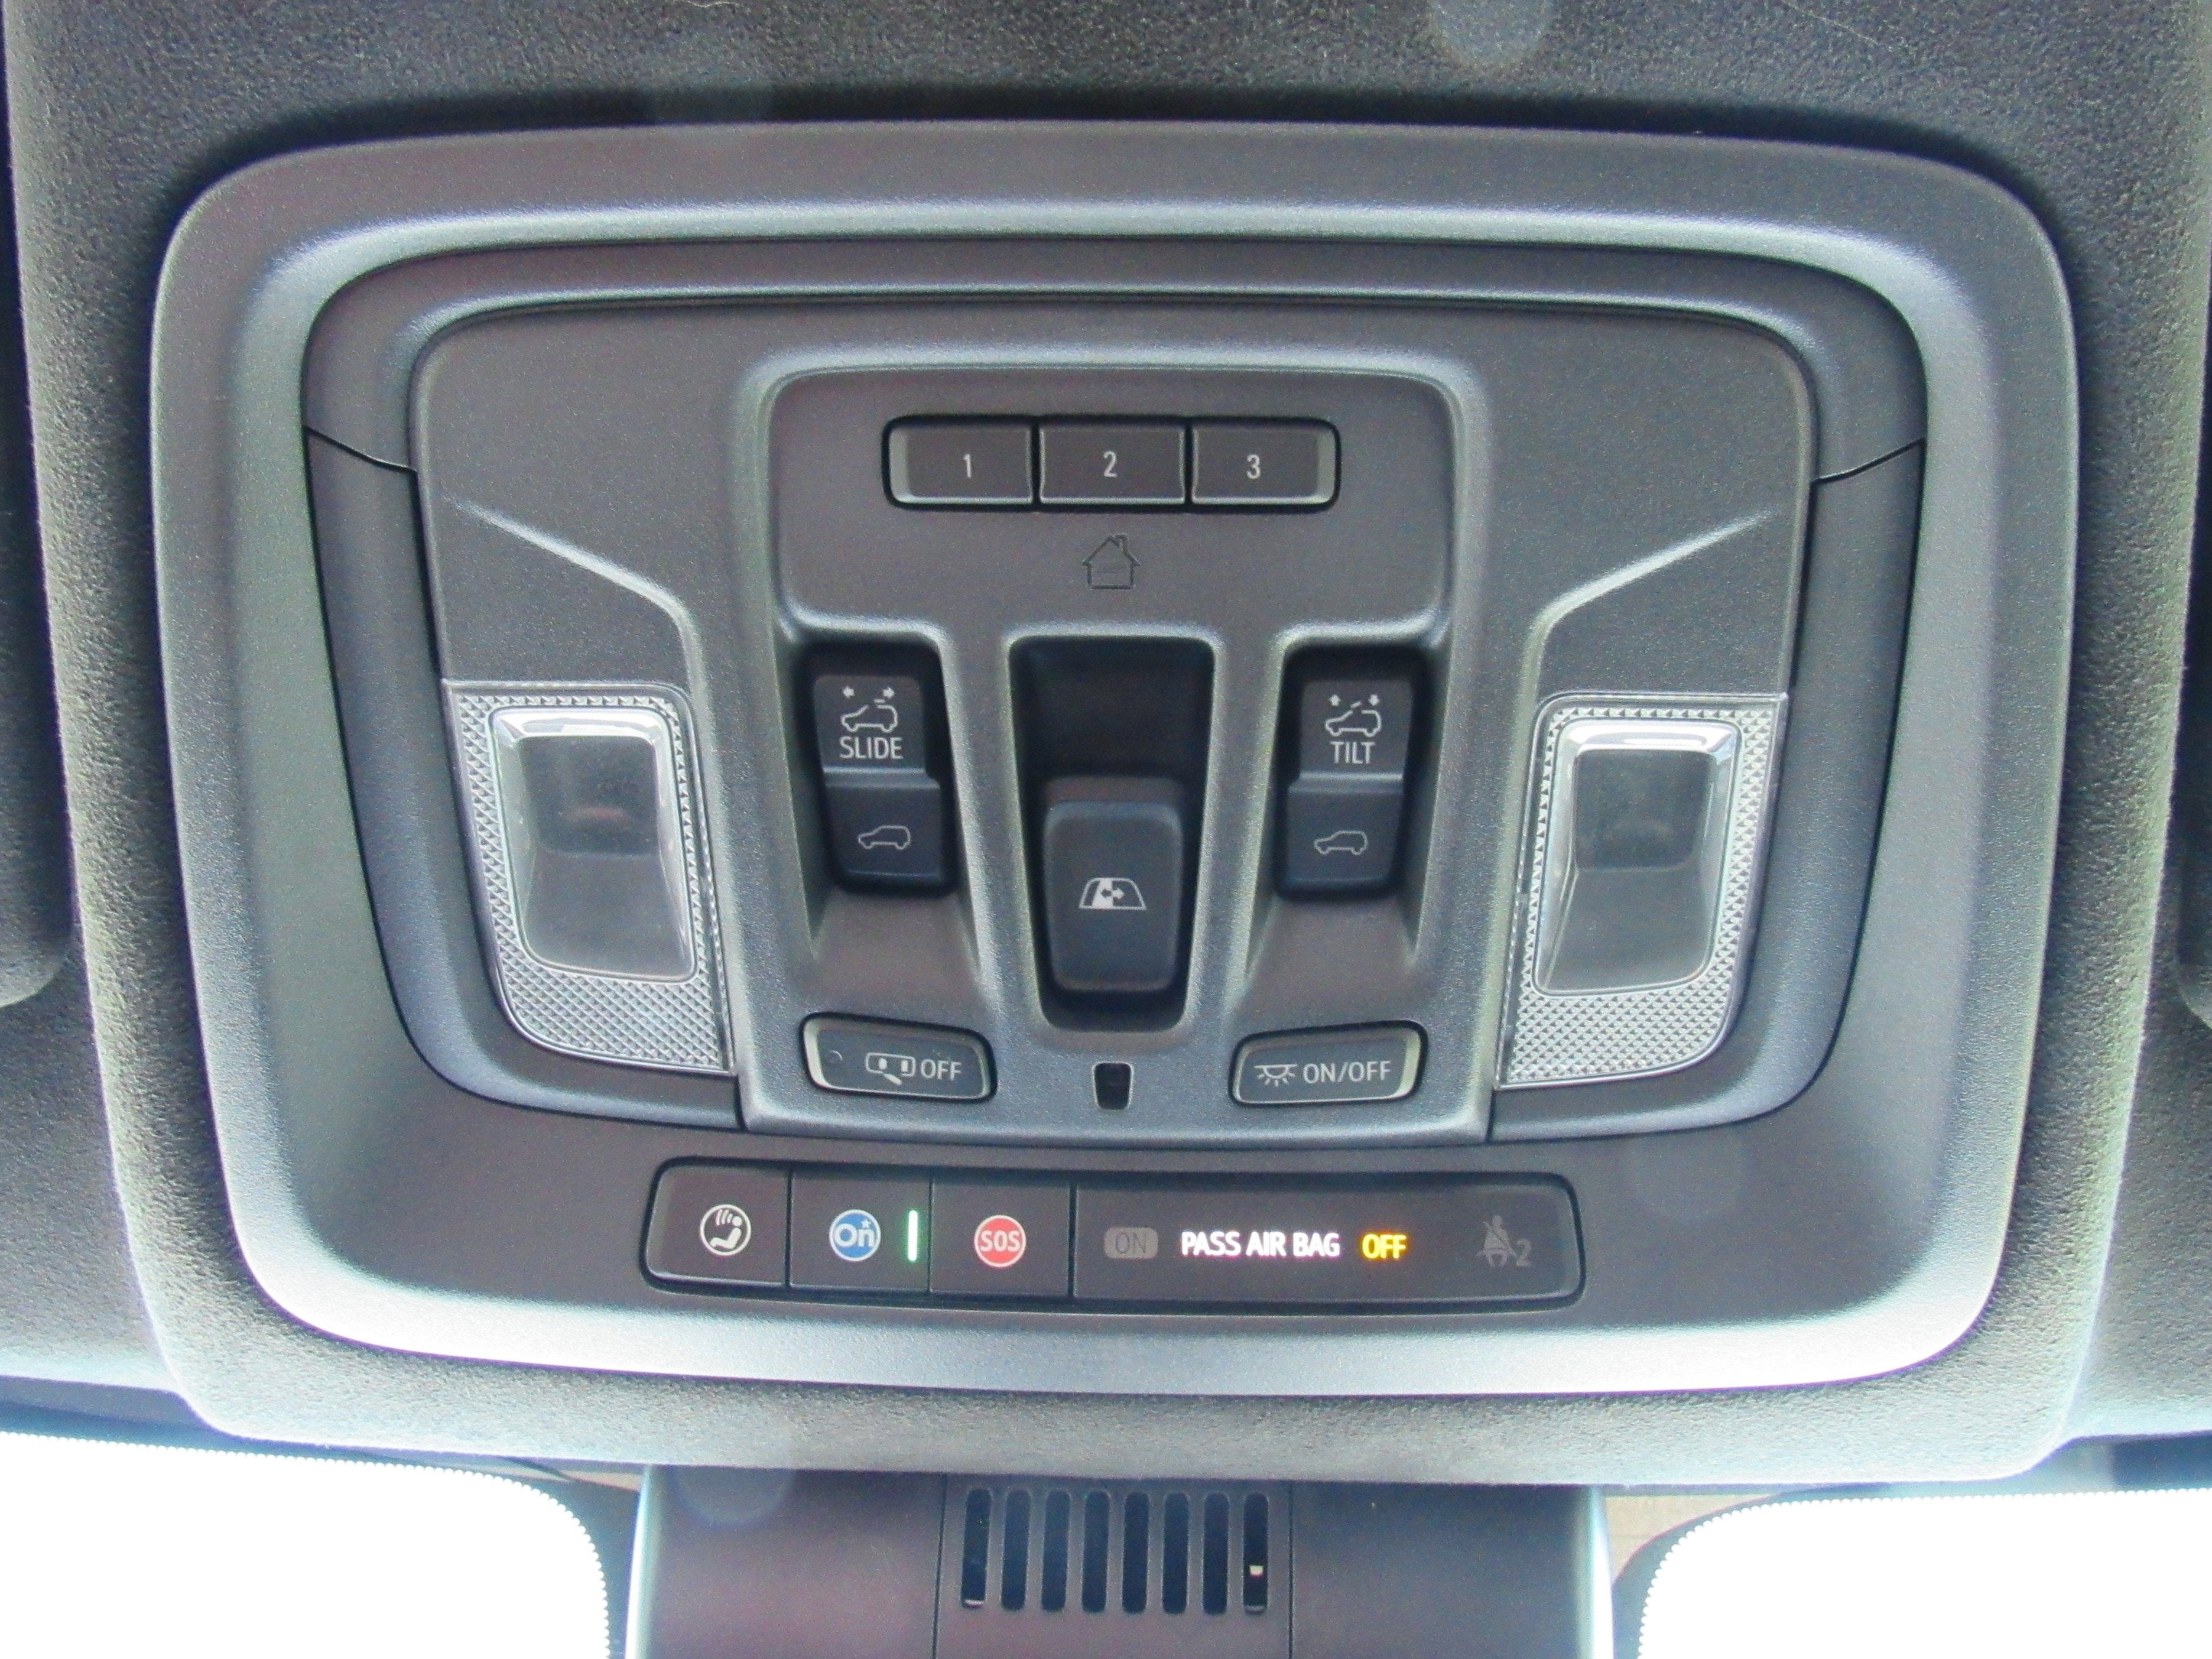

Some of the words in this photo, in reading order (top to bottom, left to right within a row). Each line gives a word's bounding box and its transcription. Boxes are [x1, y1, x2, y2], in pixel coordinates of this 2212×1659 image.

[963, 454, 972, 478] 1
[1103, 451, 1118, 478] 2
[1246, 454, 1262, 480] 3
[839, 736, 903, 759] SLIDE
[1330, 741, 1376, 764] TILT
[920, 1059, 962, 1082] OFF
[1302, 1061, 1391, 1084] ON/OFF
[980, 1229, 1021, 1252] SOS
[1115, 1231, 1147, 1254] ON
[1181, 1231, 1241, 1257] PASS
[1245, 1231, 1287, 1257] AIR
[1292, 1232, 1340, 1257] BAG
[1362, 1233, 1407, 1259] OFF
[1516, 1239, 1532, 1267] 2
